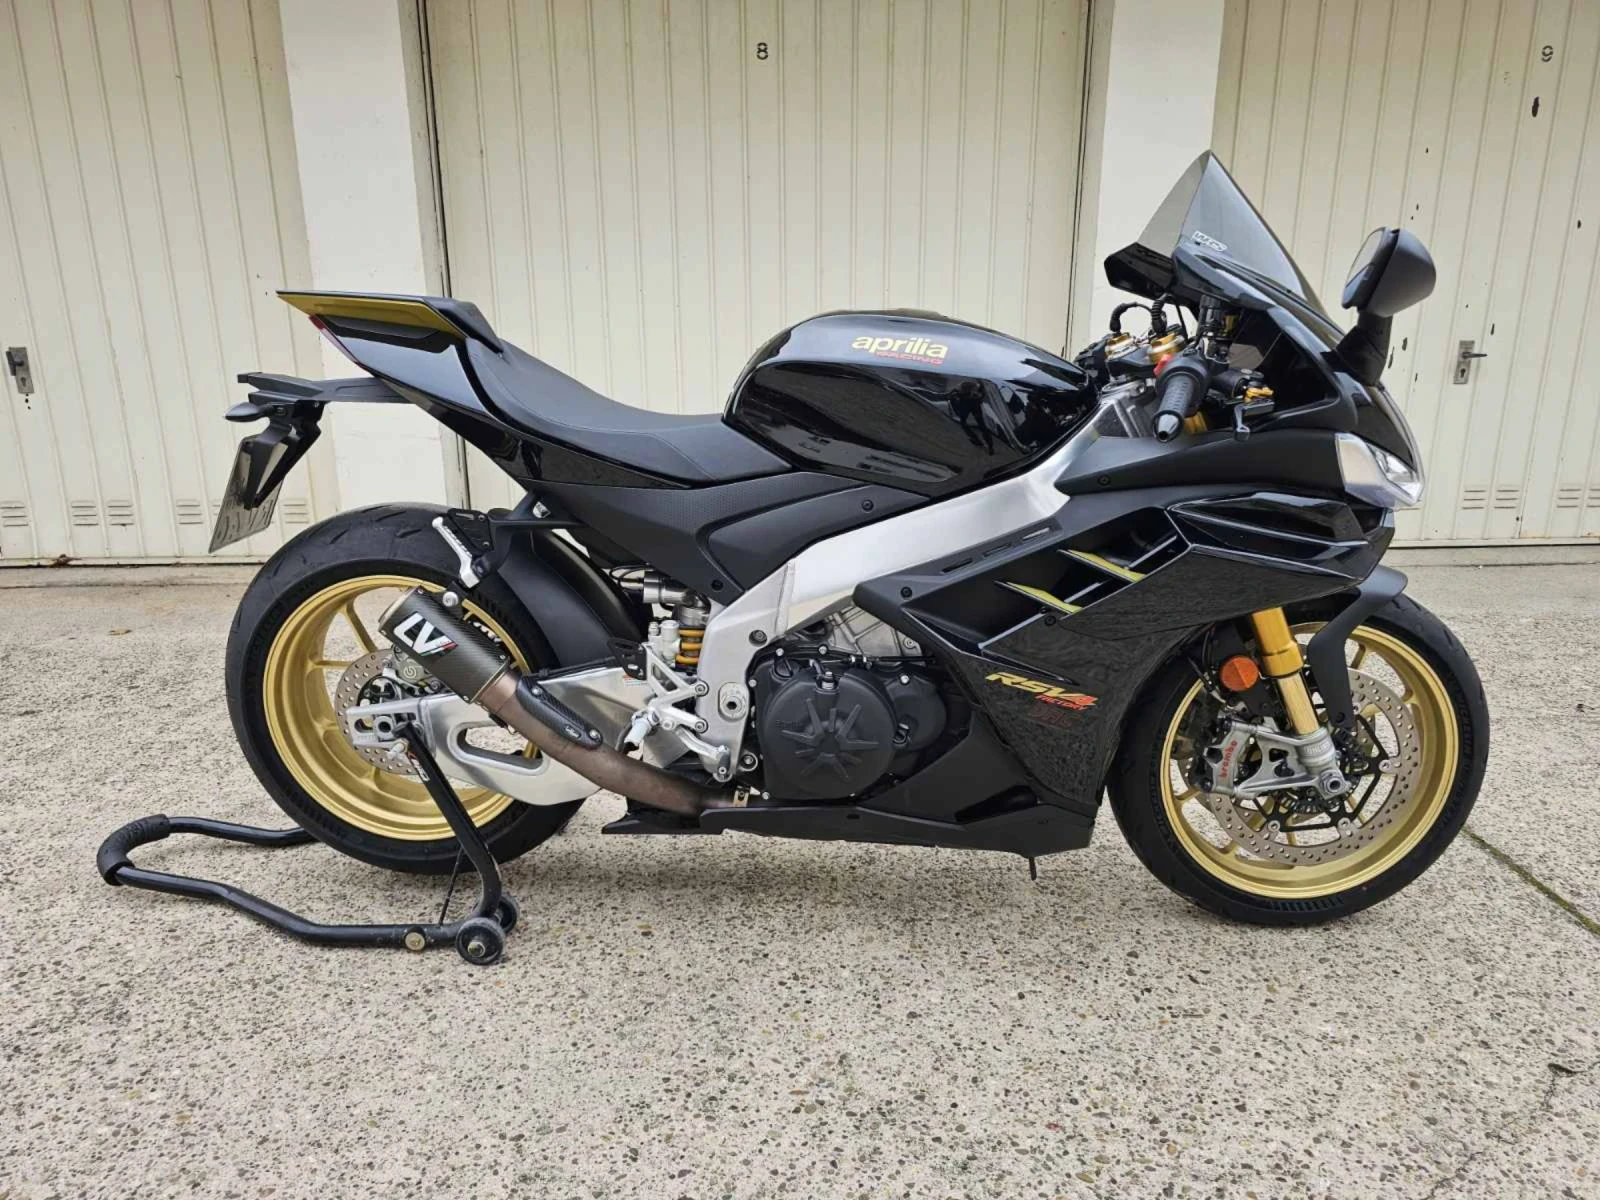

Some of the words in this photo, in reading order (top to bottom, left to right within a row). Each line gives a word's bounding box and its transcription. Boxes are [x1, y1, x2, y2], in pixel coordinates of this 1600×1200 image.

[756, 42, 769, 60] 8
[1541, 45, 1553, 62] 9
[851, 336, 949, 358] aprilia
[393, 612, 454, 656] LV
[985, 671, 1098, 705] RSV4
[1218, 739, 1238, 778] brembo
